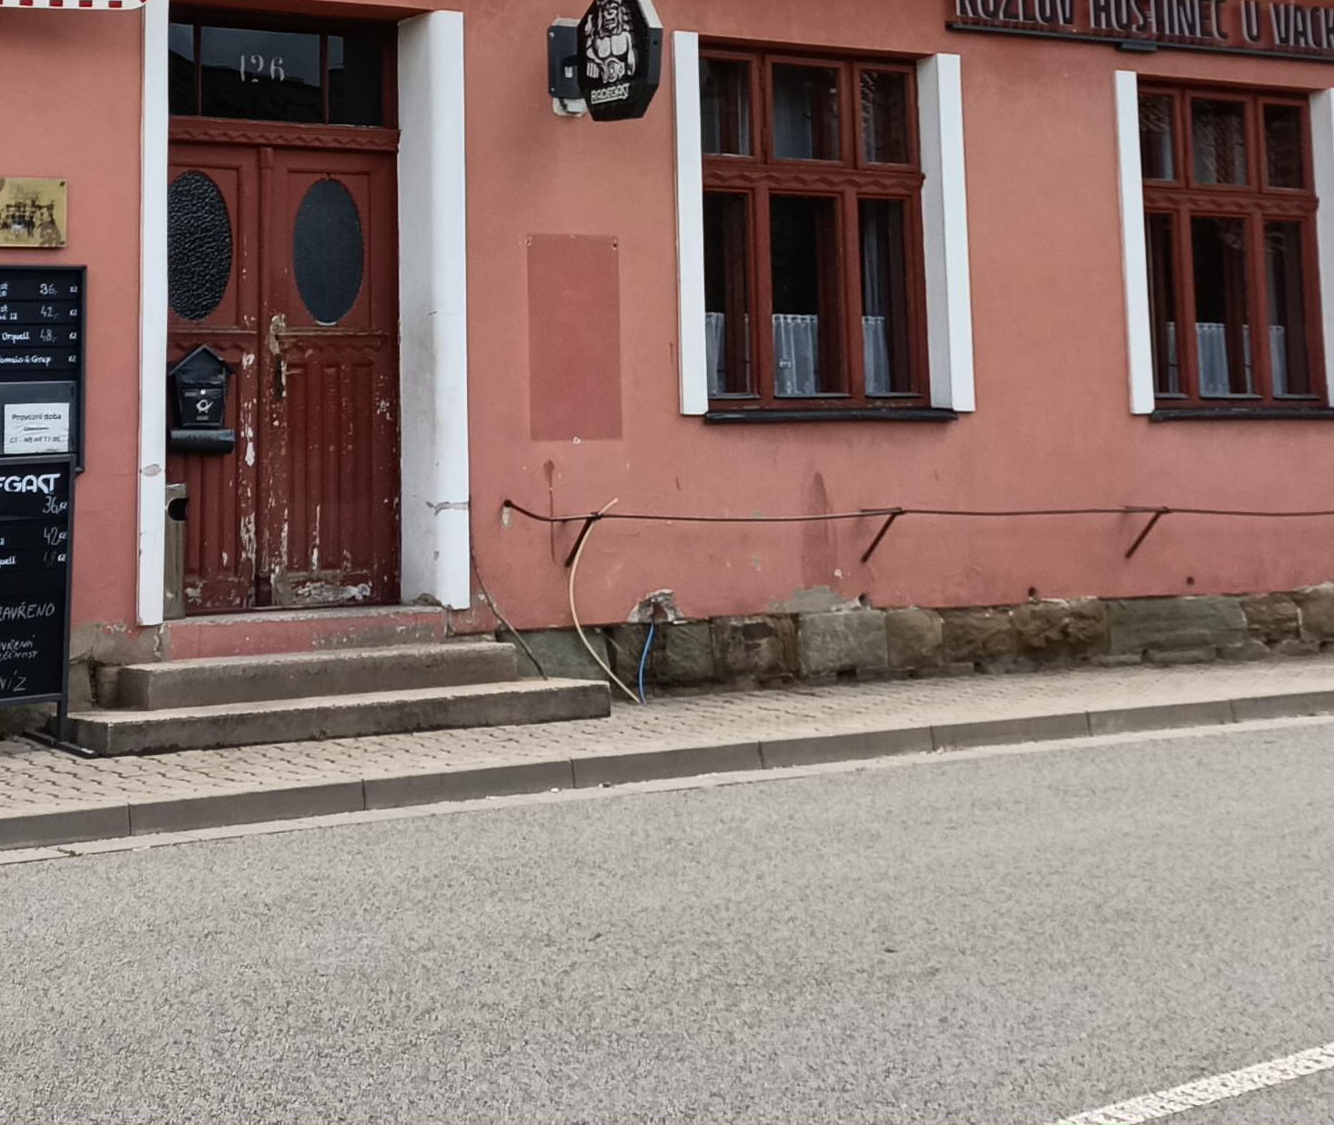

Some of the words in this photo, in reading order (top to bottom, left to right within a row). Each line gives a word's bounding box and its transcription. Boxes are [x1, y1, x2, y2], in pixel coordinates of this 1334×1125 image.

[1240, 0, 1261, 43] U
[240, 55, 285, 83] 126
[2, 331, 30, 344] Urquell
